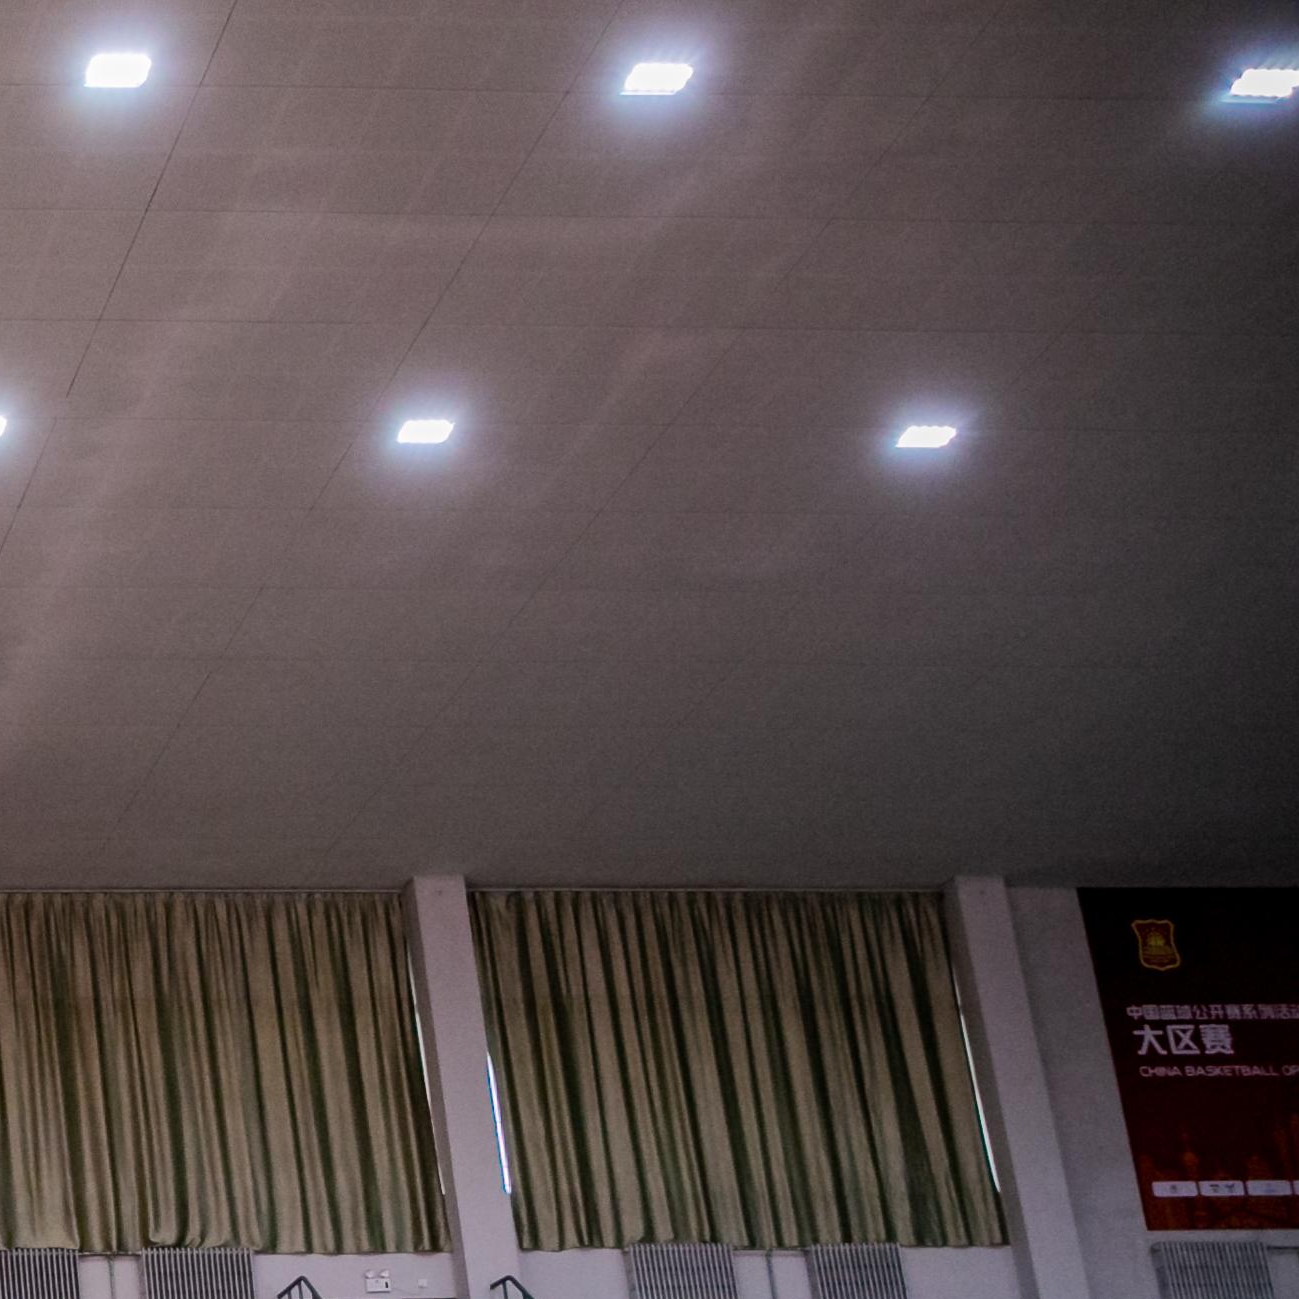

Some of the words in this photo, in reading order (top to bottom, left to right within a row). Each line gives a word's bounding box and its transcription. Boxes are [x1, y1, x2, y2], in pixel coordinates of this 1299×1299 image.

[1133, 1024, 1234, 1055] 大区赛
[1139, 1066, 1182, 1077] CHINA
[1185, 1065, 1276, 1077] BASKETBALL
